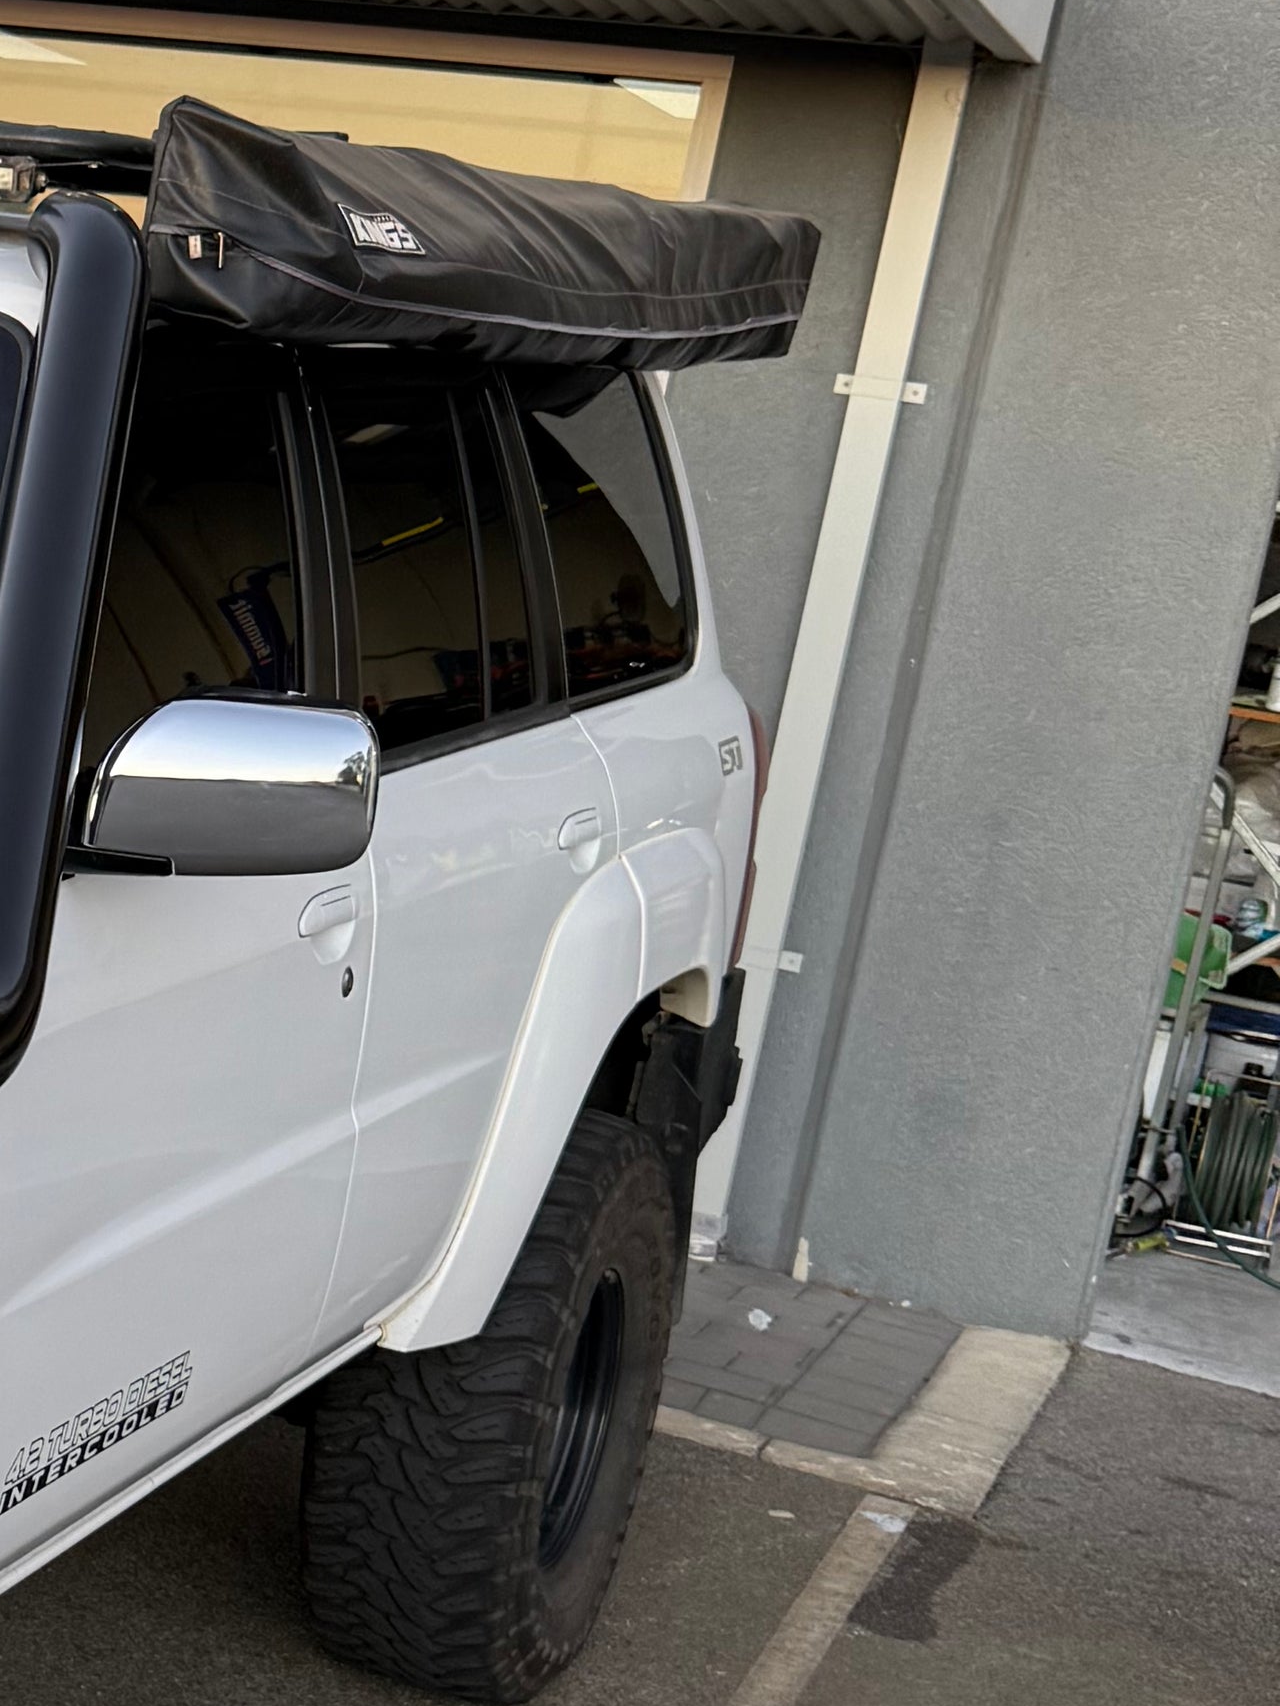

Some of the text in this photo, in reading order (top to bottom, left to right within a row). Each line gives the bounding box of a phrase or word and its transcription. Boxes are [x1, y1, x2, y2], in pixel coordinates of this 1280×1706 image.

[348, 212, 417, 250] KINGS
[718, 735, 744, 777] ST
[4, 1350, 192, 1486] 4.2 TURBO DIESEL
